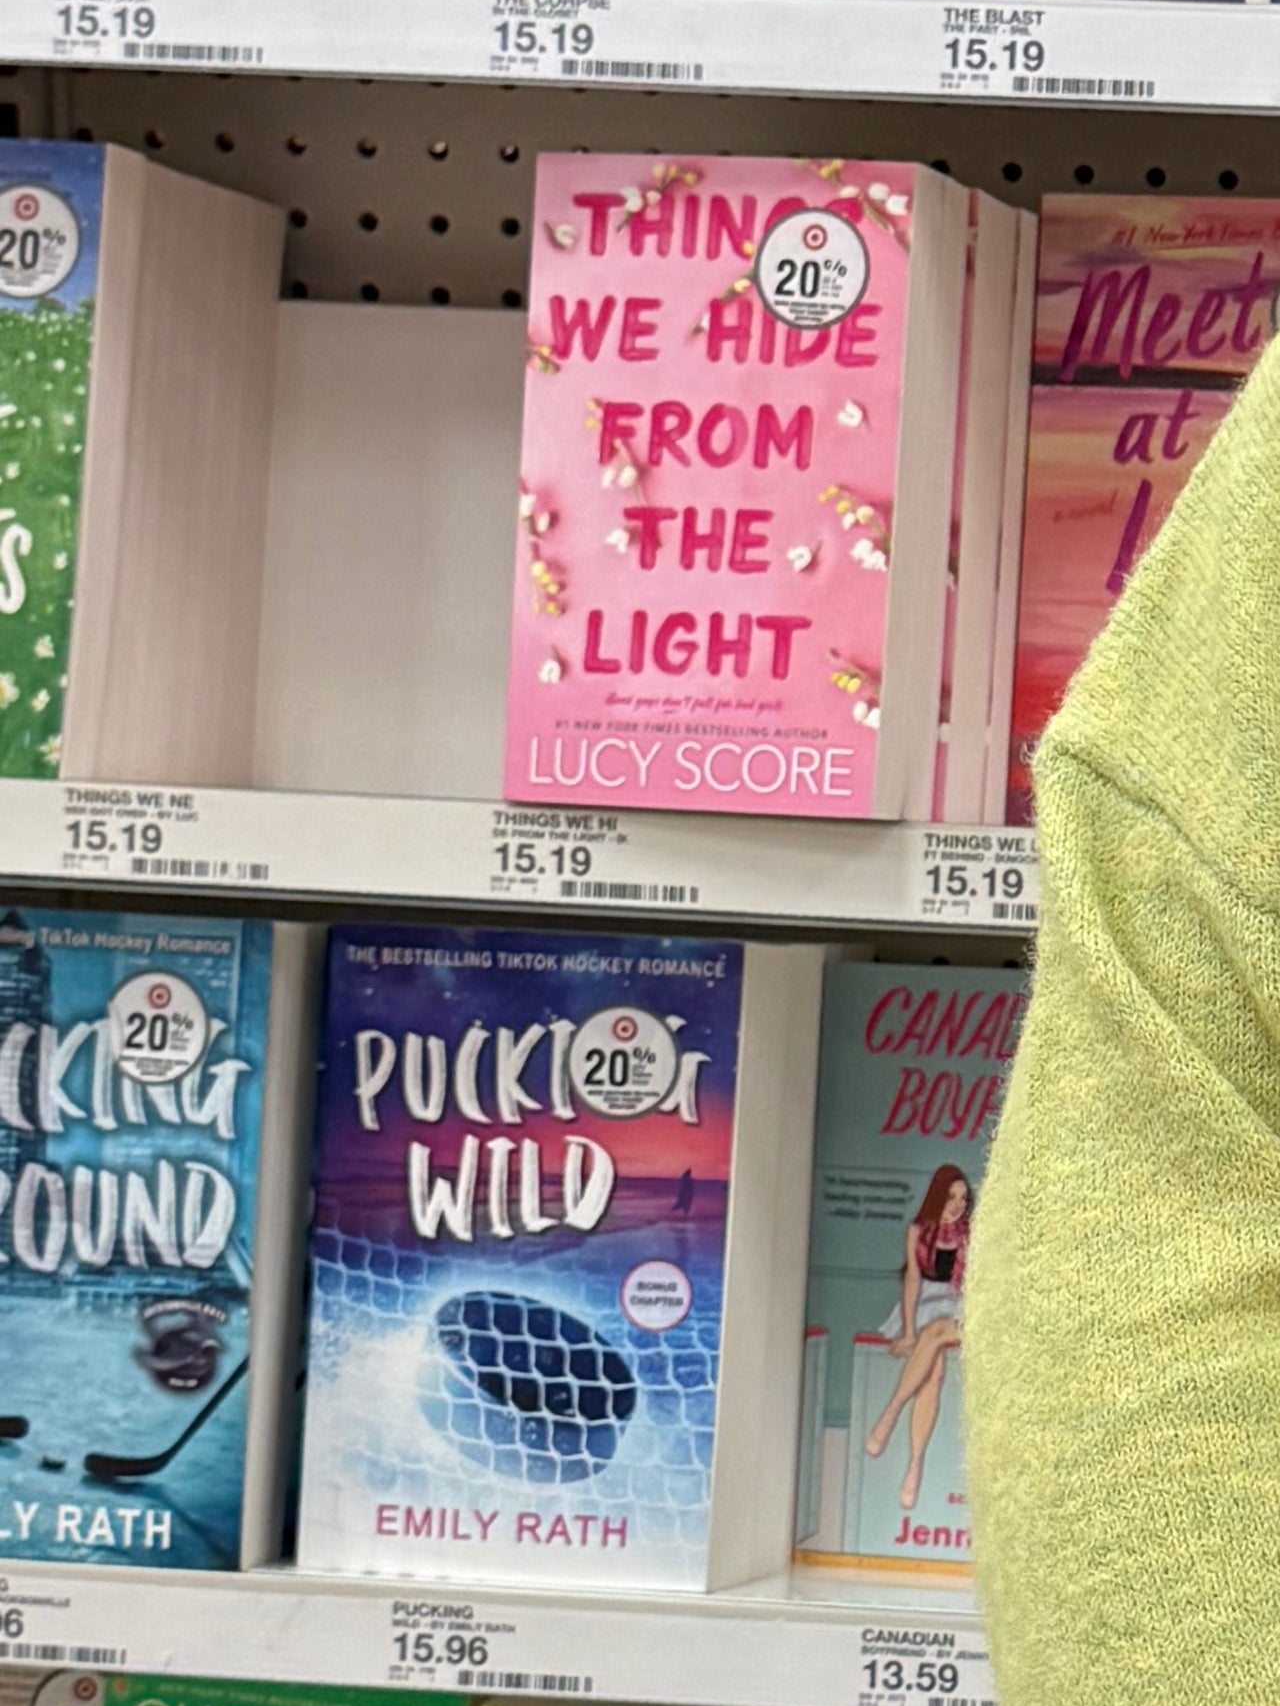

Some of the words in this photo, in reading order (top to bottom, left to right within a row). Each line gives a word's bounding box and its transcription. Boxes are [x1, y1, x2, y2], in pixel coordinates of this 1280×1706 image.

[58, 7, 155, 37] 15.19
[944, 8, 980, 25] THE
[984, 9, 1045, 28] BLAST
[495, 22, 594, 55] 15.19
[944, 39, 1045, 72] 15.19
[551, 295, 662, 362] WE
[1061, 251, 1264, 383] Meet
[599, 401, 812, 470] FROM
[1112, 390, 1198, 464] at
[623, 508, 774, 572] THE
[584, 610, 811, 680] LIGHT
[529, 737, 664, 786] LUCY
[675, 743, 855, 796] SCORE
[66, 788, 130, 807] THINGS
[136, 793, 163, 807] WE
[170, 794, 193, 808] NE
[67, 822, 162, 852] 15.19
[494, 812, 560, 829] THINGS
[565, 815, 593, 829] WE
[599, 817, 617, 830] HI
[925, 834, 993, 851] THINGS
[998, 836, 1026, 852] WE
[495, 844, 591, 875] 15.19
[926, 867, 1024, 898] 15.19
[157, 935, 232, 955] Romance
[347, 946, 377, 965] THE
[381, 948, 492, 969] BESTSELLING
[497, 952, 558, 971] TIKTOK
[563, 955, 633, 973] HOCKEY
[638, 960, 726, 979] ROMANCE
[409, 1136, 615, 1241] WILD
[56, 1510, 171, 1550] RATH
[376, 1506, 498, 1541] EMILY
[517, 1514, 628, 1546] RATH
[393, 1601, 474, 1619] PUCKING
[394, 1633, 489, 1665] 15.96
[862, 1629, 955, 1648] CANADIAN
[863, 1660, 958, 1692] 13.59
